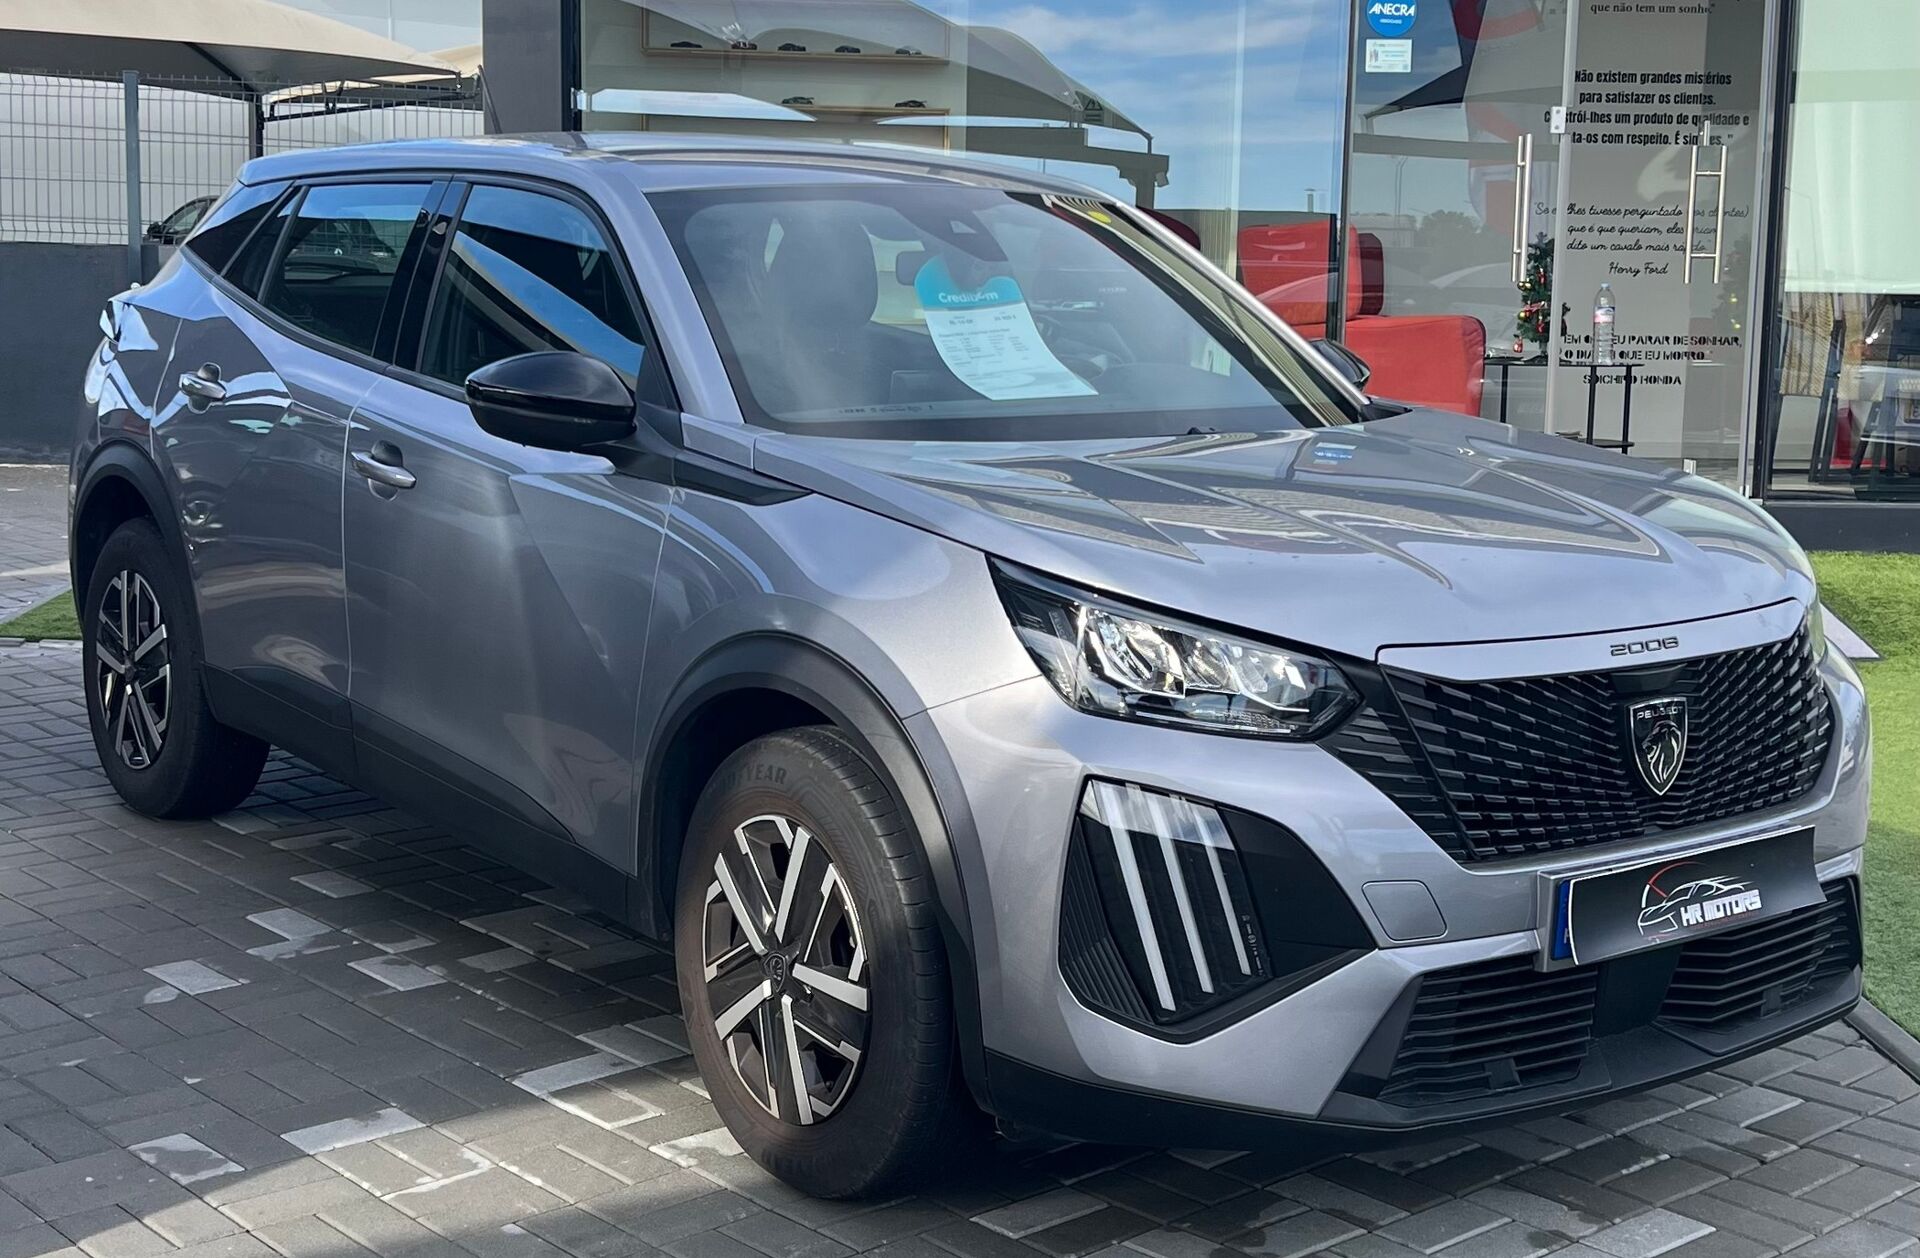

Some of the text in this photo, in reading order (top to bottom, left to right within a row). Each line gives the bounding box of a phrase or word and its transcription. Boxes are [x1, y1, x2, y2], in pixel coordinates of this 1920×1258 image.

[1369, 2, 1416, 16] ANECRA
[1590, 3, 1610, 14] que
[1613, 2, 1633, 13] não
[1636, 3, 1655, 13] tem
[1658, 4, 1675, 13] um
[1574, 69, 1593, 82] Não
[1596, 70, 1637, 83] existem
[1640, 71, 1681, 85] grandes
[1579, 92, 1602, 104] para
[1605, 90, 1656, 104] satisfazer
[1658, 94, 1671, 104] os
[1544, 110, 1612, 123] Ctrói-lhes
[1614, 113, 1631, 123] um
[1633, 112, 1673, 126] produto
[1676, 112, 1689, 125] de
[1742, 115, 1750, 126] e
[1601, 133, 1624, 144] com
[1626, 131, 1671, 146] respeito.
[1674, 130, 1681, 145] É
[1682, 132, 1725, 146] sies.
[1567, 202, 1586, 215] lhes
[1623, 204, 1683, 219] perguntado
[1567, 225, 1587, 235] que
[1588, 222, 1595, 232] é
[1597, 225, 1616, 236] que
[1618, 224, 1662, 236] queriam,
[1666, 222, 1684, 234] eles
[1567, 238, 1588, 250] dito
[1610, 238, 1643, 250] cavalo
[1645, 243, 1669, 251] mais
[1608, 261, 1669, 277] Henry Ford
[1628, 335, 1670, 345] PARAR
[1672, 335, 1689, 345] DE
[1689, 335, 1742, 348] SONHAR,
[1564, 349, 1573, 359] O
[1618, 350, 1642, 360] QUE
[1645, 350, 1661, 360] EU
[1640, 375, 1682, 385] HONDA
[1609, 636, 1679, 657] 2008
[1636, 705, 1683, 721] PEUGEOT
[1680, 902, 1704, 927] HR
[1702, 889, 1762, 922] MOTORS
